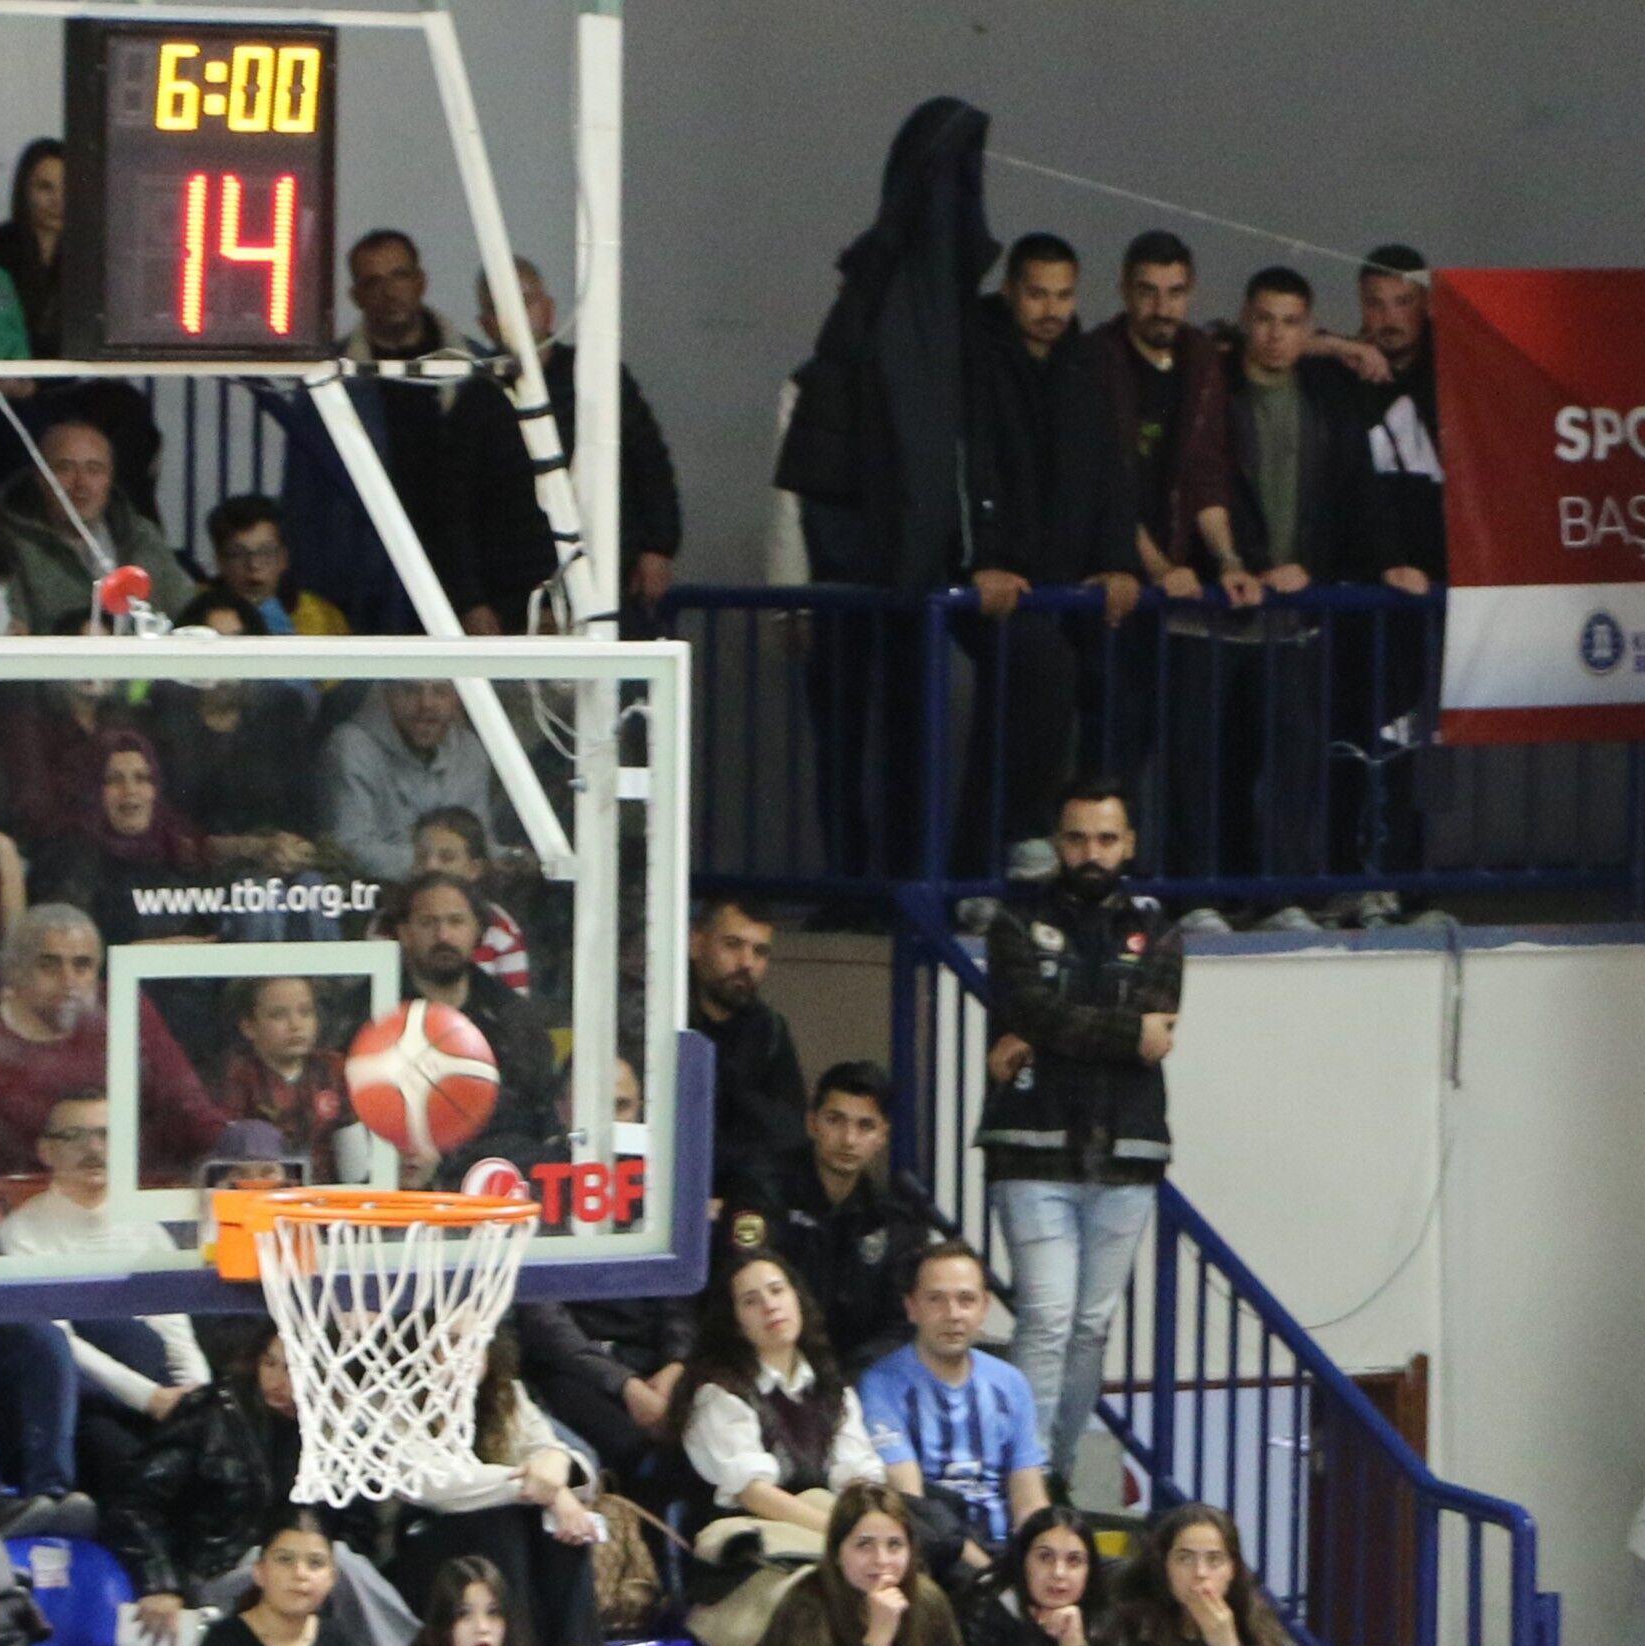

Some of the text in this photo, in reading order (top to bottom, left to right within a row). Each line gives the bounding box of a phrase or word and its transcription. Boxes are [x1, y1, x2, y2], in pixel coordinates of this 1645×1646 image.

[154, 43, 322, 133] 6:00
[181, 173, 296, 336] 14
[132, 877, 381, 919] www.tbf.org.tr
[530, 1158, 646, 1225] TBF
